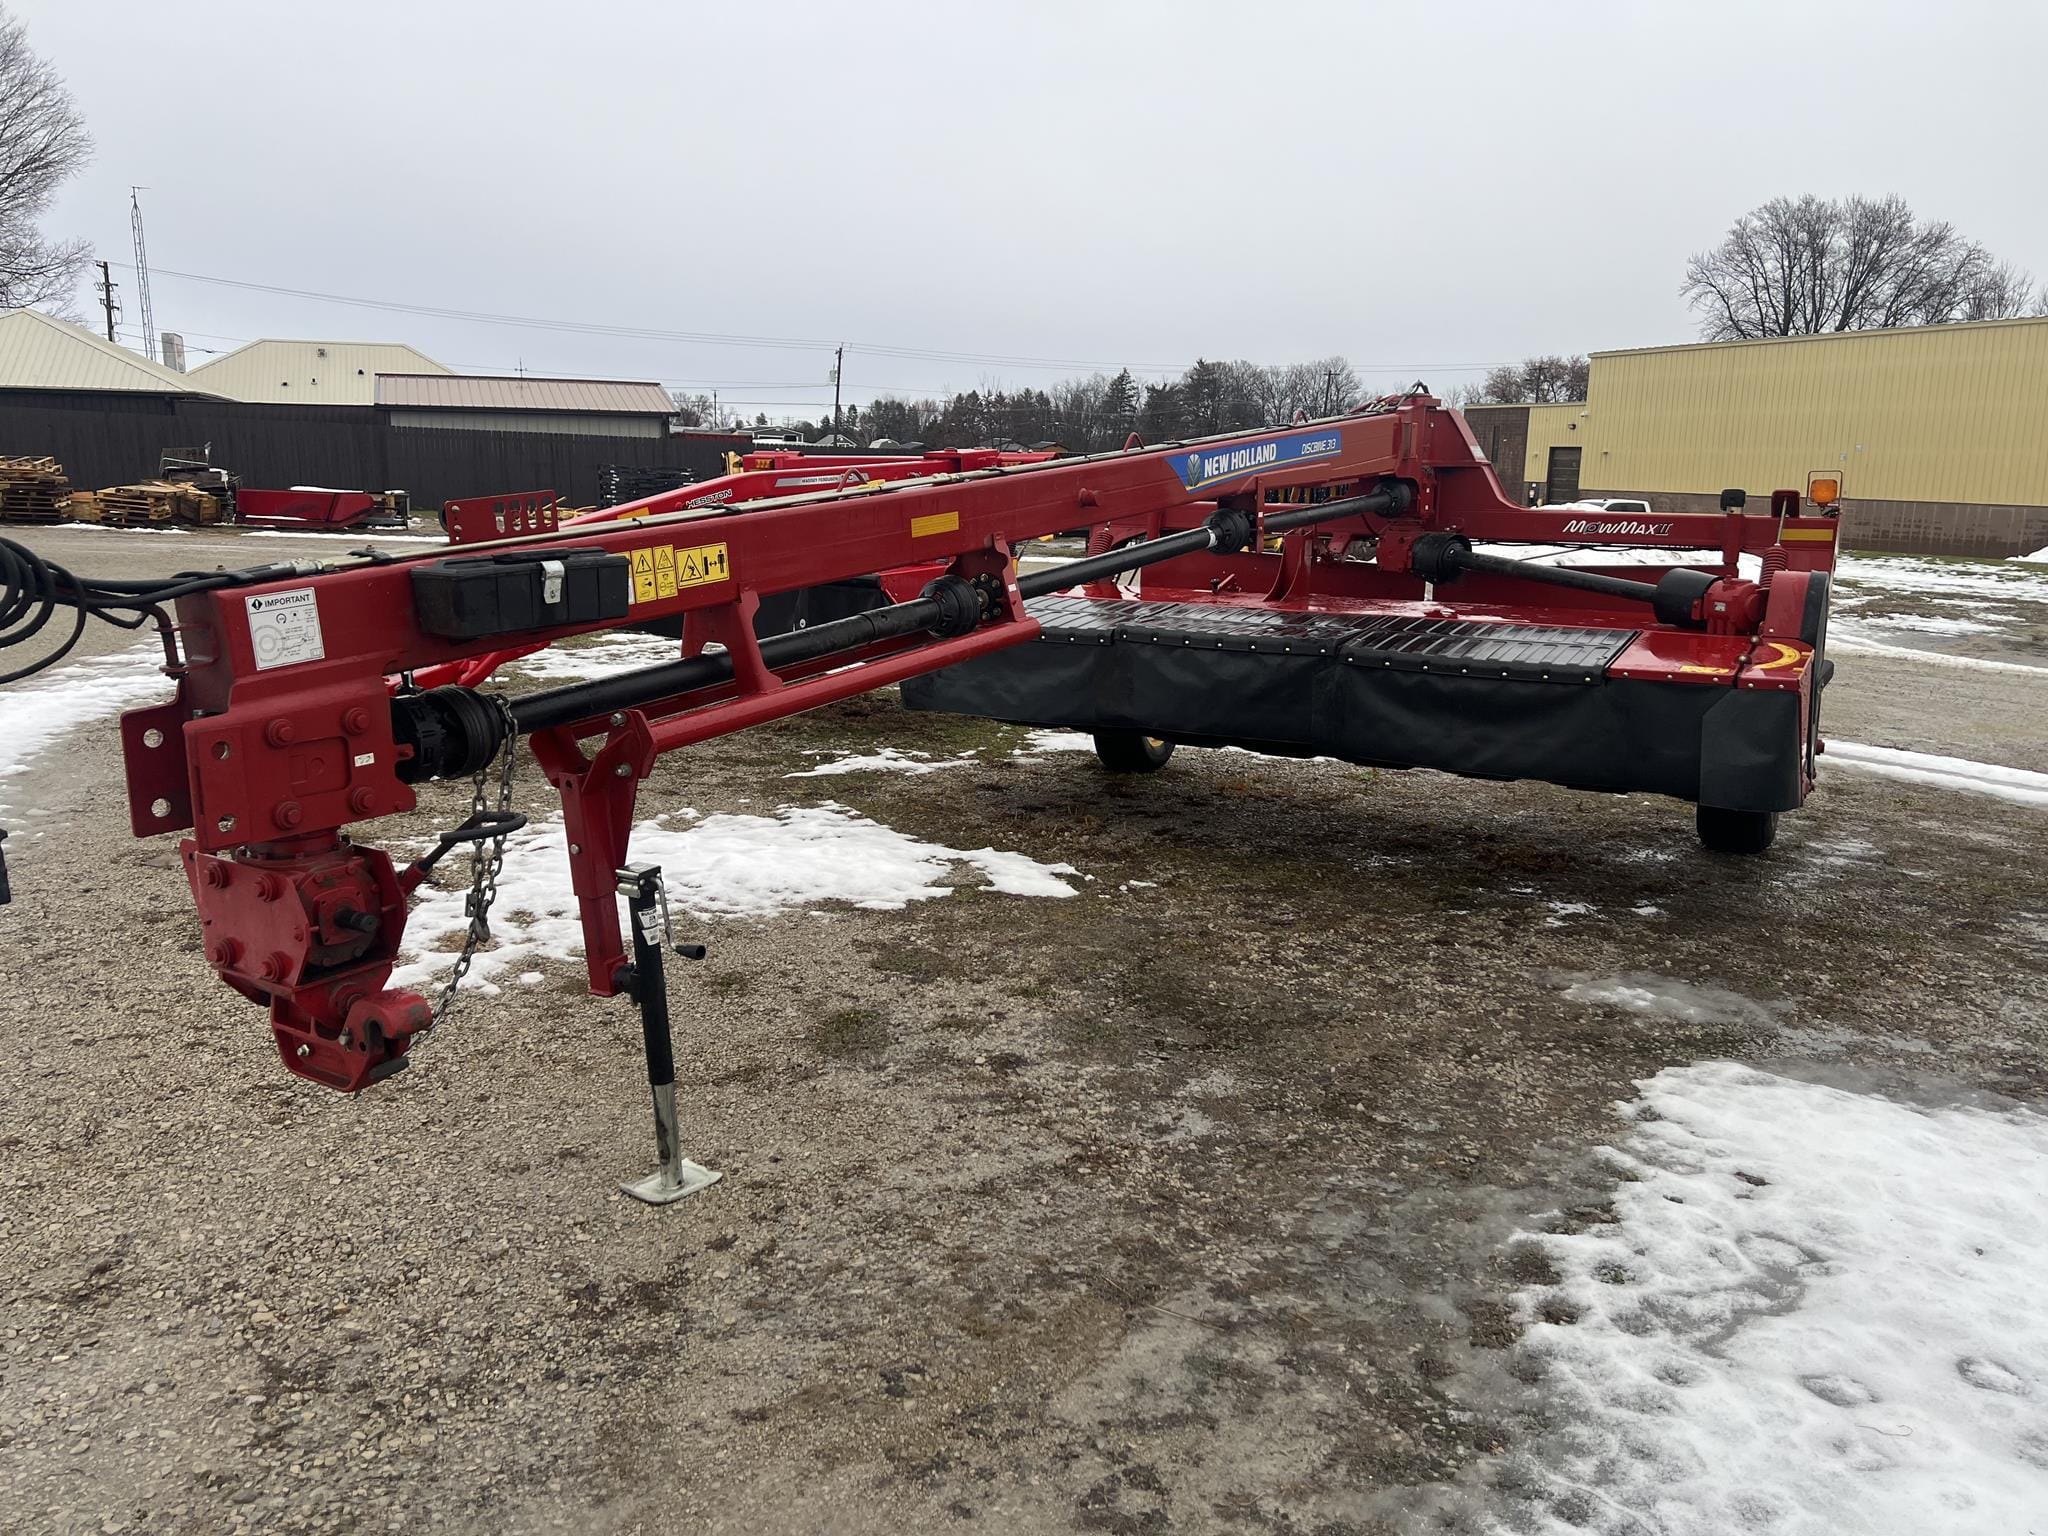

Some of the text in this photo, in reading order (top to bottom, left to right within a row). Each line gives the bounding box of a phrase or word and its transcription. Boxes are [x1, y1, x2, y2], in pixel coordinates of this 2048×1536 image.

[1204, 443, 1277, 478] NEW HOLLAND
[685, 488, 733, 509] HESSTON
[264, 593, 310, 608] IMPORTANT
